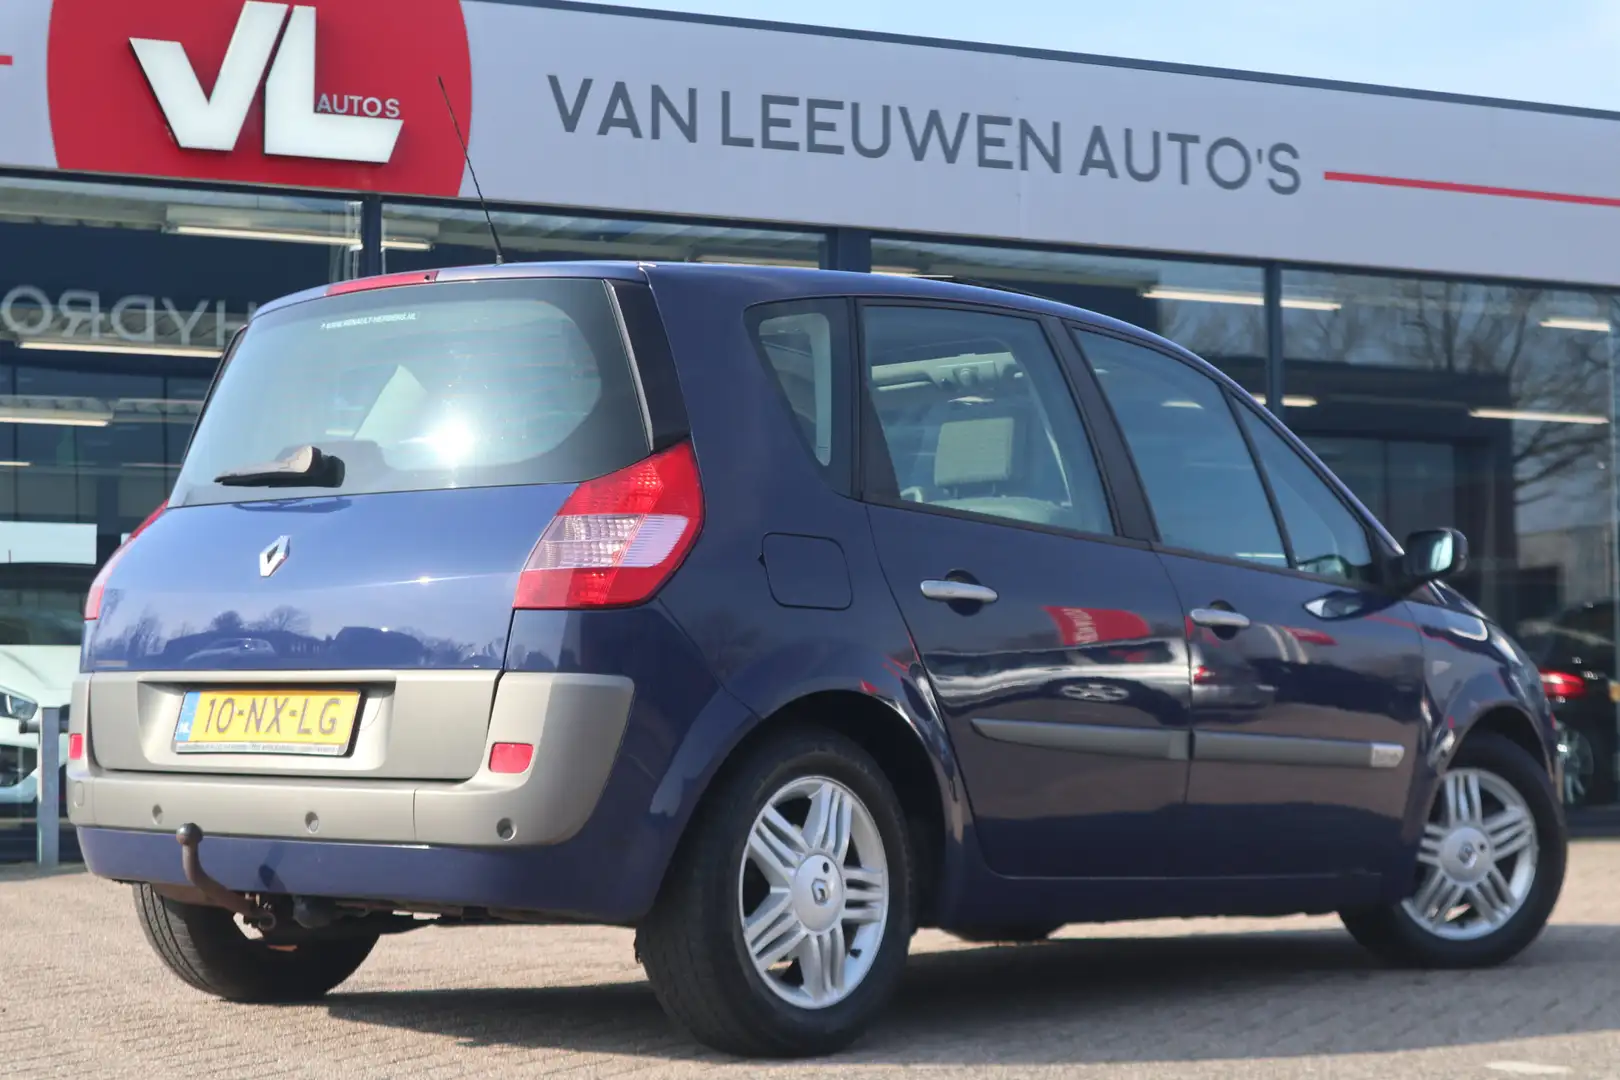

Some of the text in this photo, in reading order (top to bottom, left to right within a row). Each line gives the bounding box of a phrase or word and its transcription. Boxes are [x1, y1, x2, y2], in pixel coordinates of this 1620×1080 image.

[129, 1, 403, 163] VL
[317, 93, 400, 118] AUTOS
[547, 74, 1301, 195] VAN LEEUWEN AUTO'S
[204, 697, 341, 735] 10-NX-LG
